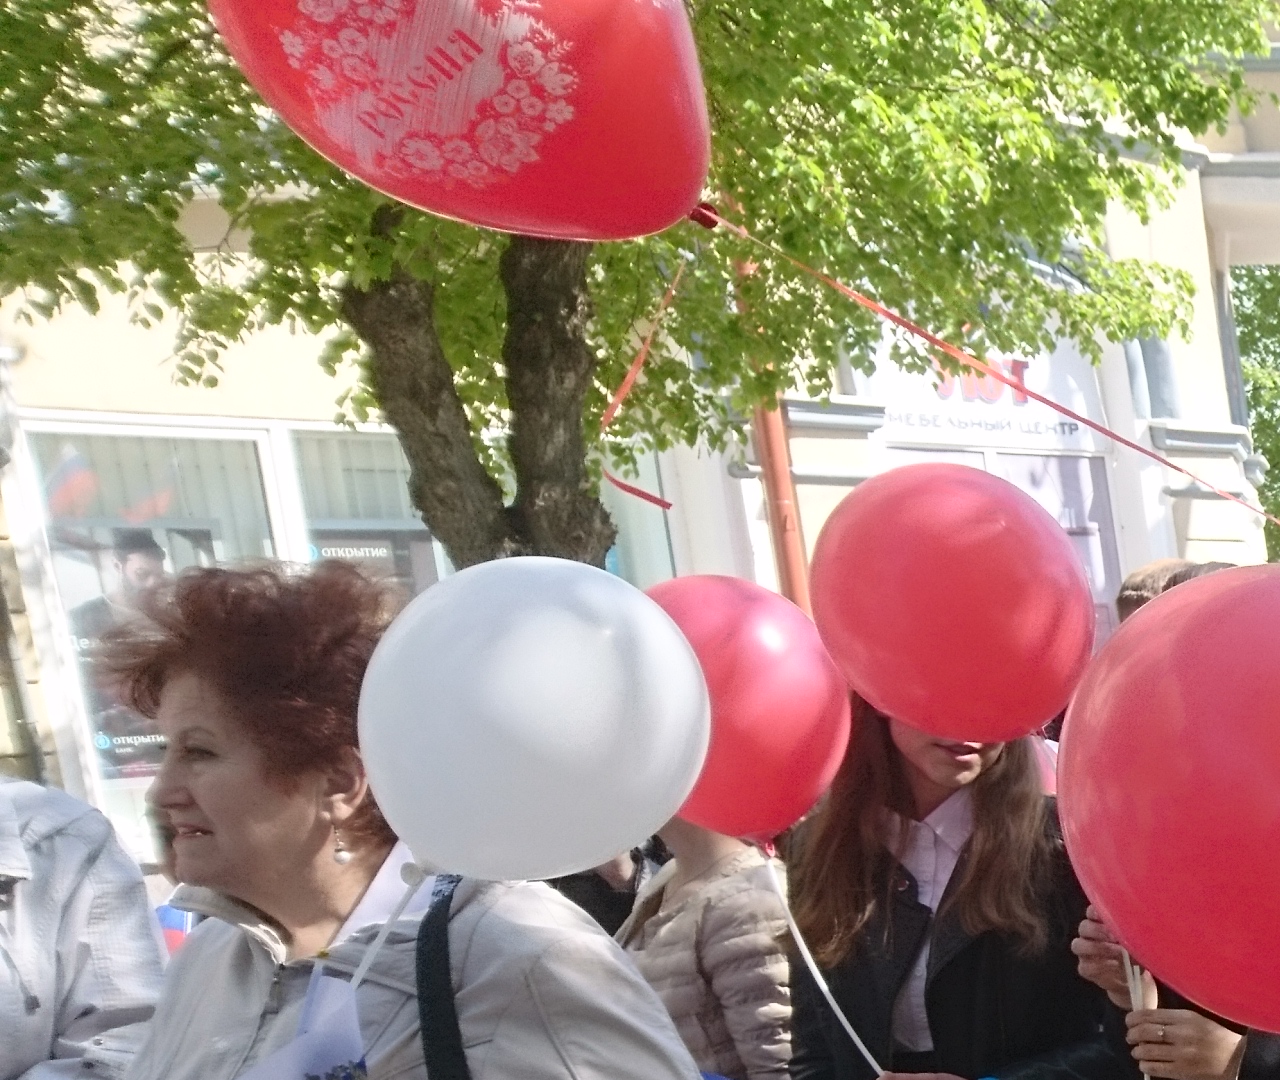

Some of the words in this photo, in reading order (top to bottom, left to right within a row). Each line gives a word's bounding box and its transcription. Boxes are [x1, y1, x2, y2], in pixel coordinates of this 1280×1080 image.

[887, 412, 1012, 432] МЕБЕЛЬНЫЙ
[1018, 421, 1079, 436] ЦЕНТР
[321, 547, 388, 557] открытие
[112, 734, 165, 747] открыти
